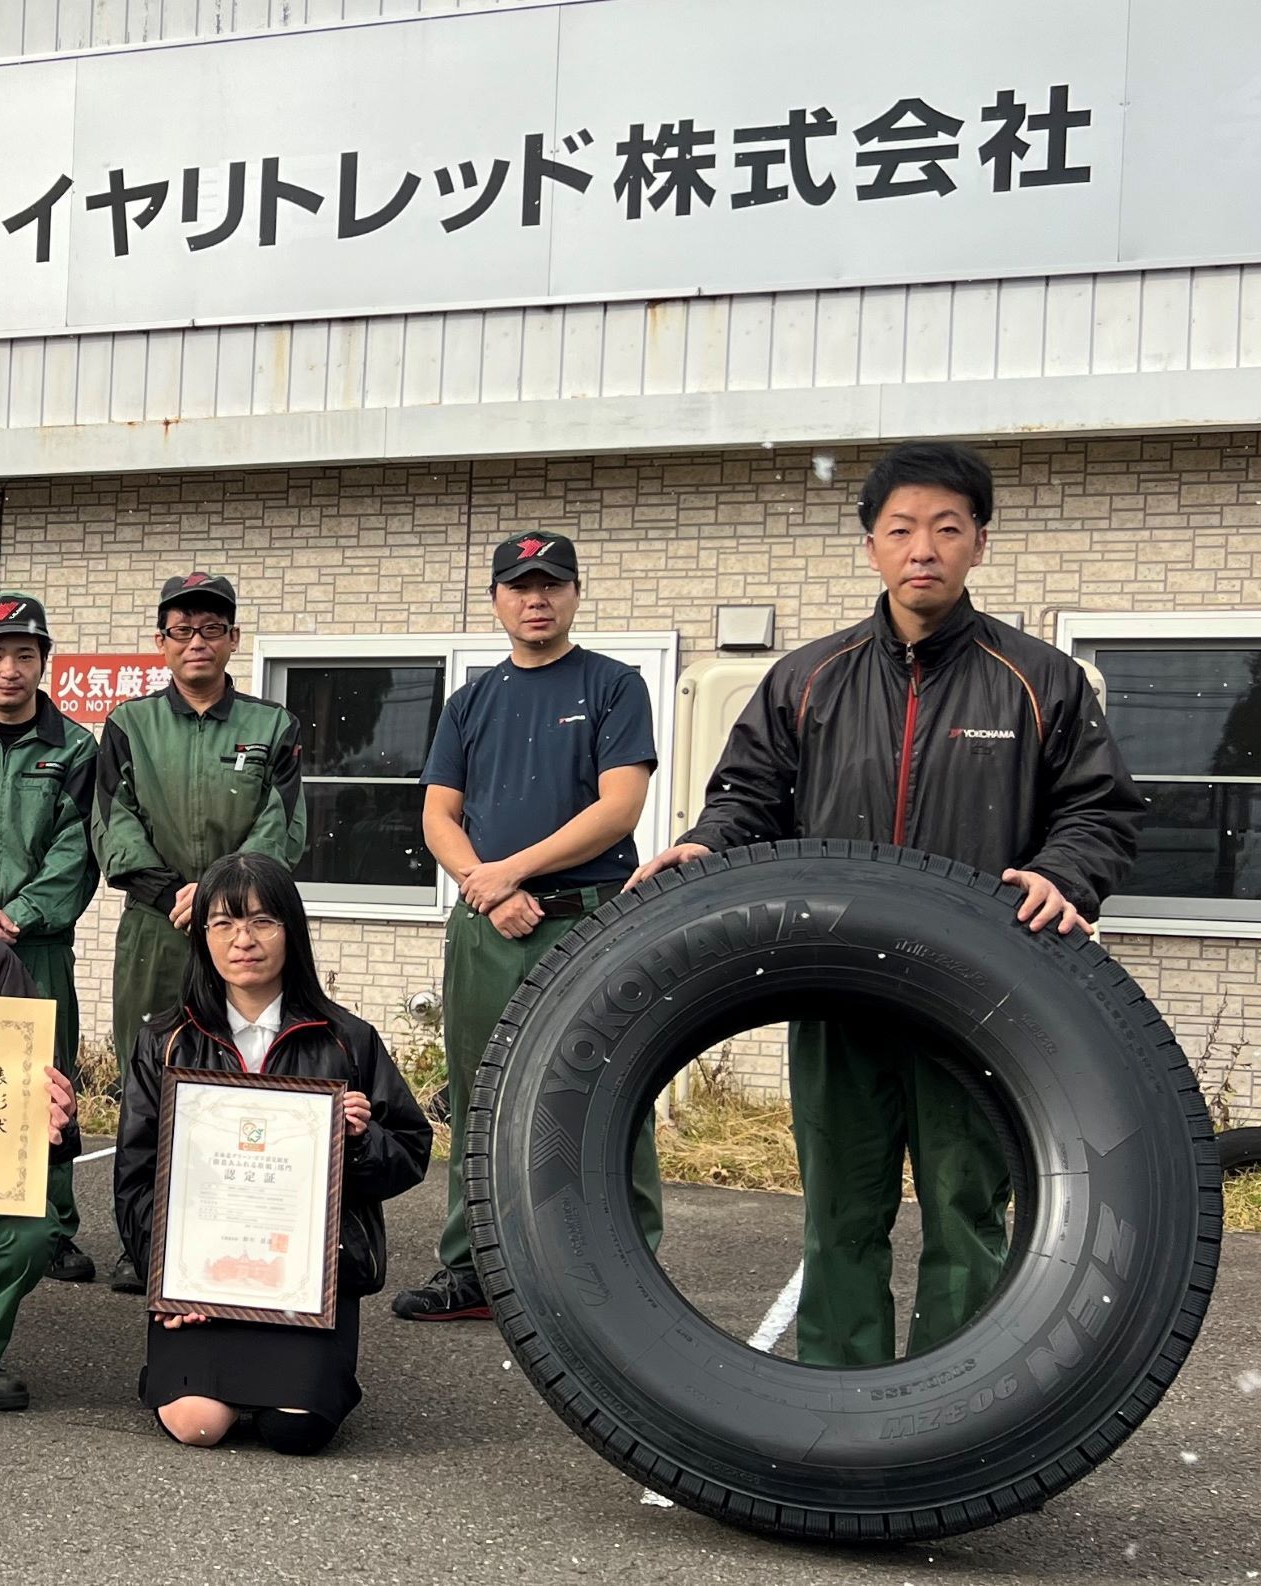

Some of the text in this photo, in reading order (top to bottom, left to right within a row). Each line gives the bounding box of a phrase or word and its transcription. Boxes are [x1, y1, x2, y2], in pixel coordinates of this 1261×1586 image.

[57, 665, 174, 698] 火気厳禁
[60, 700, 78, 712] DO
[85, 700, 111, 712] NOT
[963, 729, 1016, 739] YOKOHAMA
[542, 900, 823, 1095] YOKOHAMA
[1025, 1201, 1137, 1397] ZEN
